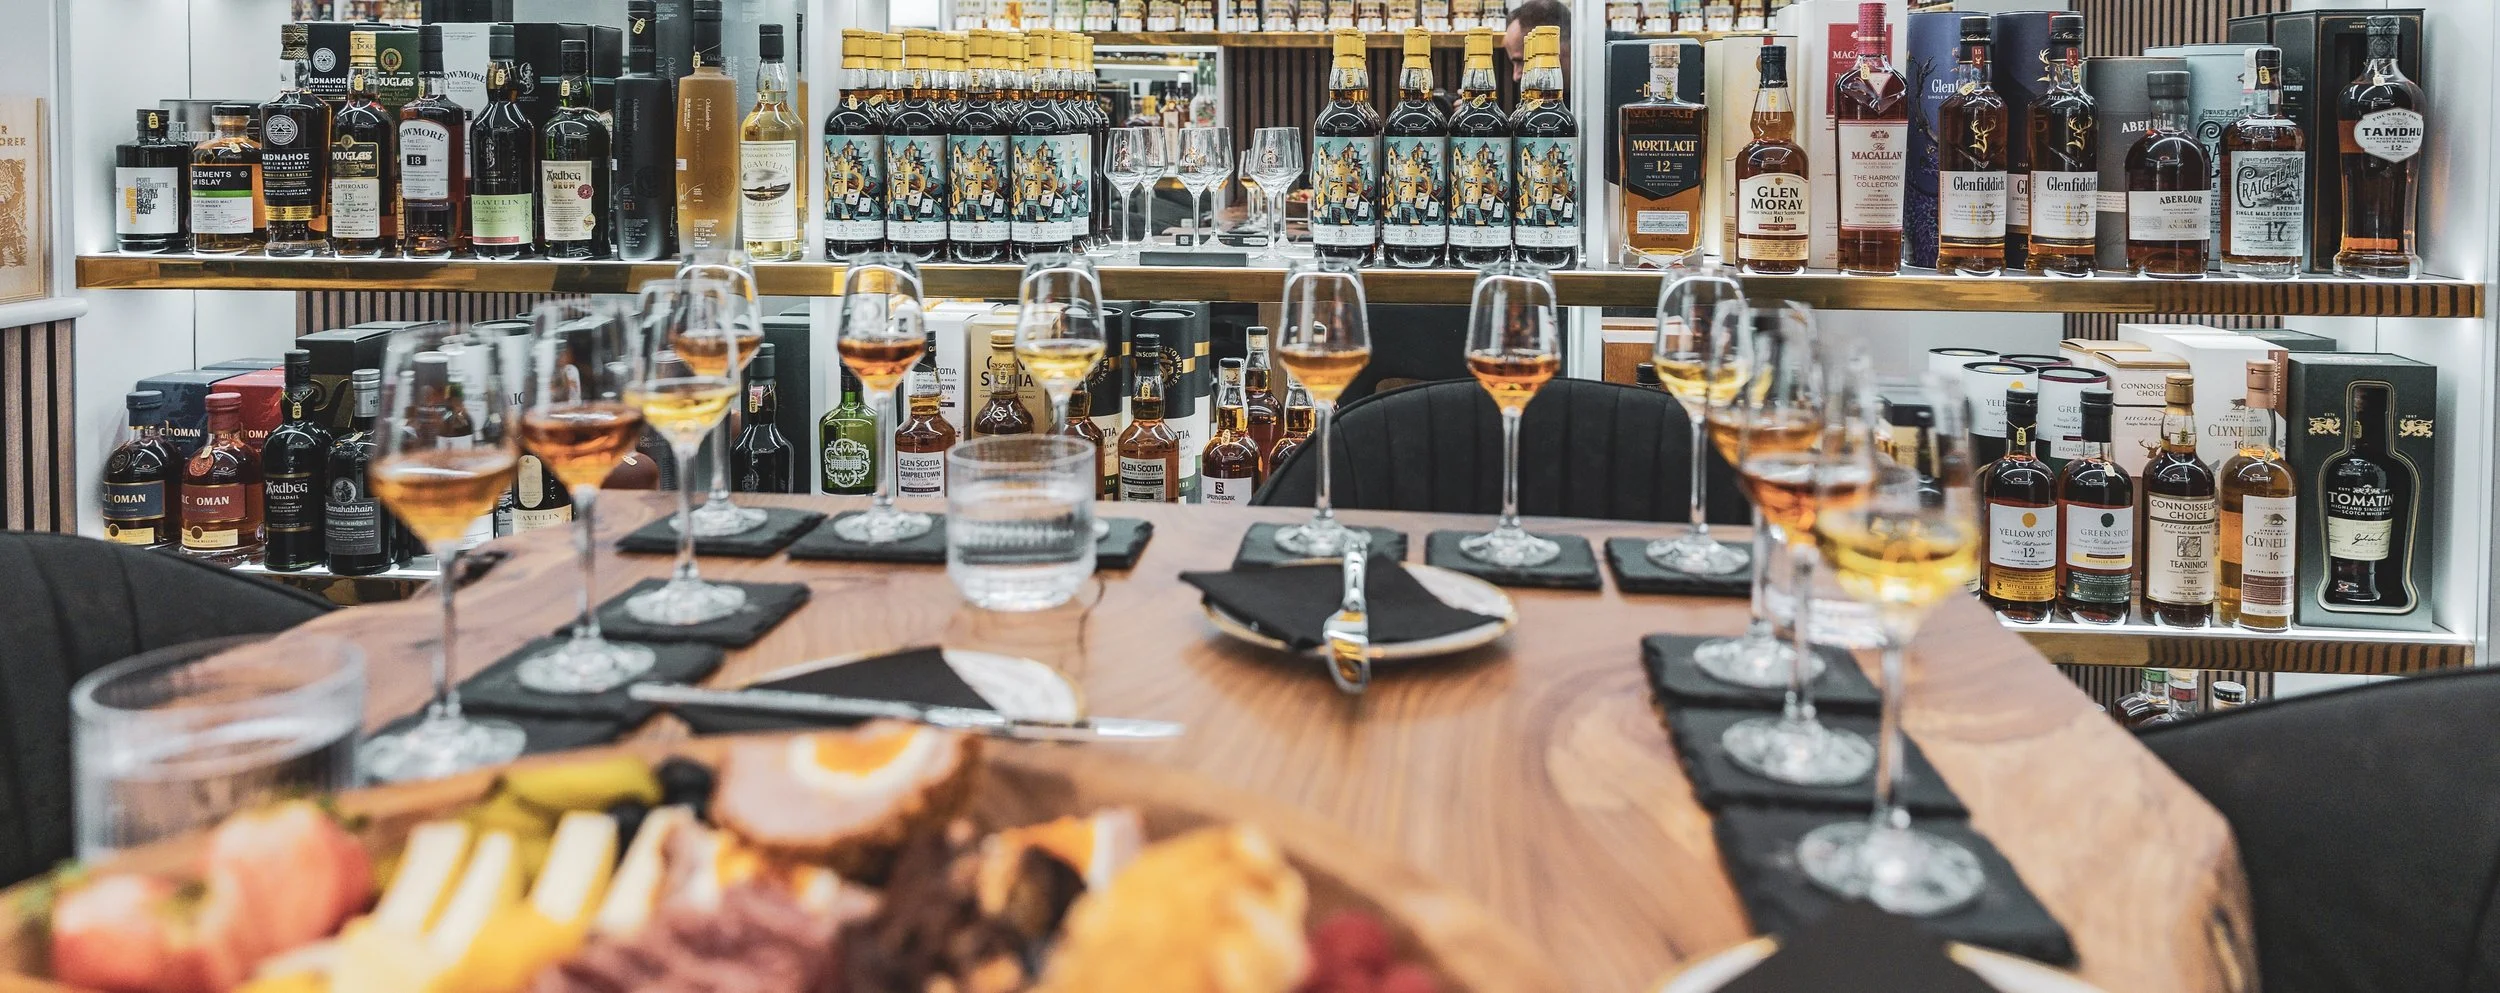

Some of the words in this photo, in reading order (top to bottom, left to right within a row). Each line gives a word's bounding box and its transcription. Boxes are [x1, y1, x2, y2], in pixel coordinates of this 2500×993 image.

[1833, 51, 1859, 59] MACA
[378, 77, 415, 87] OUGLAS
[444, 70, 487, 84] OWMORE
[2372, 112, 2407, 122] FOUNDED
[400, 127, 446, 142] OWMORE
[2362, 127, 2422, 137] TAMDHU
[1632, 140, 1695, 152] MORTLACH
[262, 153, 310, 161] ARDNAHOE
[332, 151, 373, 161] DOUGLAS
[410, 156, 421, 165] 18
[1851, 151, 1902, 160] MACALLAN
[743, 160, 790, 173] GAVULIN
[1656, 160, 1671, 172] 12
[334, 182, 369, 190] LAPHROAIG
[1953, 176, 2005, 191] Glenfiddich
[2046, 176, 2097, 192] Glenfiddich
[2236, 157, 2303, 208] CRAIGELLACHI
[1757, 186, 1799, 198] GLEN
[1750, 198, 1803, 210] MORAY
[2159, 195, 2203, 205] ABERLOUR
[1969, 202, 1995, 226] 15
[2065, 201, 2090, 226] 15
[2264, 221, 2288, 242] 17
[1160, 345, 1184, 366] ELTOWN
[981, 371, 1034, 387] STIA
[2120, 382, 2166, 390] CONNOISS
[1985, 398, 2006, 407] YELL
[2058, 405, 2081, 413] GRE
[899, 458, 915, 467] GLEN
[915, 459, 941, 467] SCOTIA
[1121, 461, 1137, 472] GLEN
[1137, 463, 1163, 472] SCOTIA
[900, 470, 941, 478] CAMPBELTOWN
[1206, 493, 1236, 501] SPRINGBANK
[2328, 491, 2394, 508] TOMATIN
[325, 502, 374, 513] unnahabhain
[2151, 499, 2215, 511] CONNOISSEU
[2331, 503, 2362, 511] HIGHLAND
[515, 513, 559, 522] GAVULIN
[2169, 511, 2207, 520] CHOICE
[1999, 528, 2036, 538] YELLOW
[2037, 529, 2054, 538] SPOT
[2080, 529, 2111, 537] GREEN
[2113, 529, 2129, 537] SPOT
[2245, 534, 2287, 548] CLYNELI
[2023, 547, 2035, 558] 12
[2269, 551, 2279, 561] 16
[2170, 560, 2208, 569] TEANINICH
